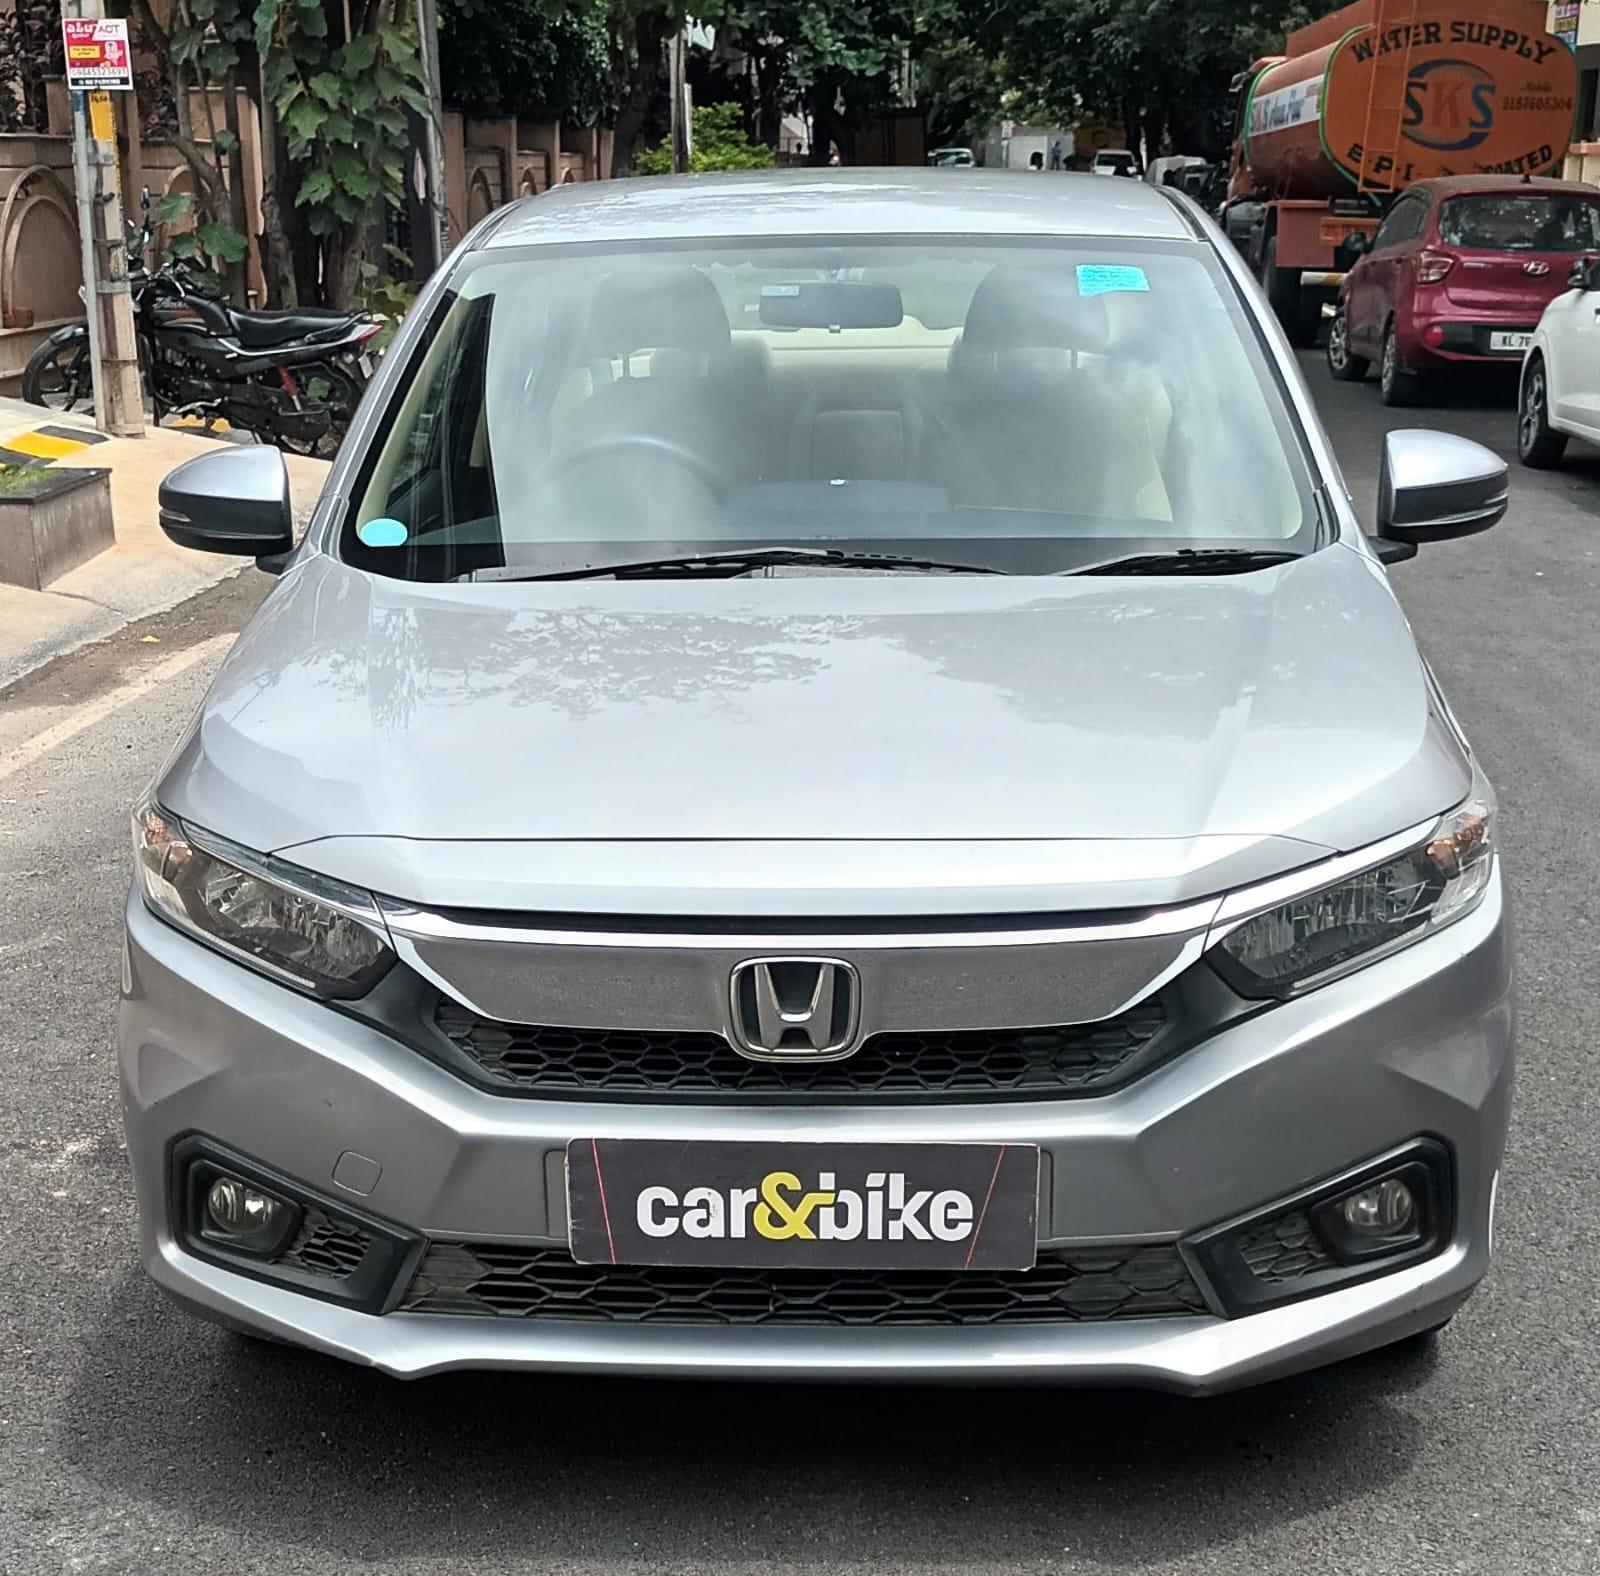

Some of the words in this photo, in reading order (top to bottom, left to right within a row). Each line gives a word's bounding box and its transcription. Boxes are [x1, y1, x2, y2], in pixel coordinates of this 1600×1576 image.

[1351, 22, 1441, 63] WATER
[1450, 21, 1557, 65] SUPPLY
[1401, 81, 1496, 129] SKS
[636, 1171, 974, 1241] car&bike
